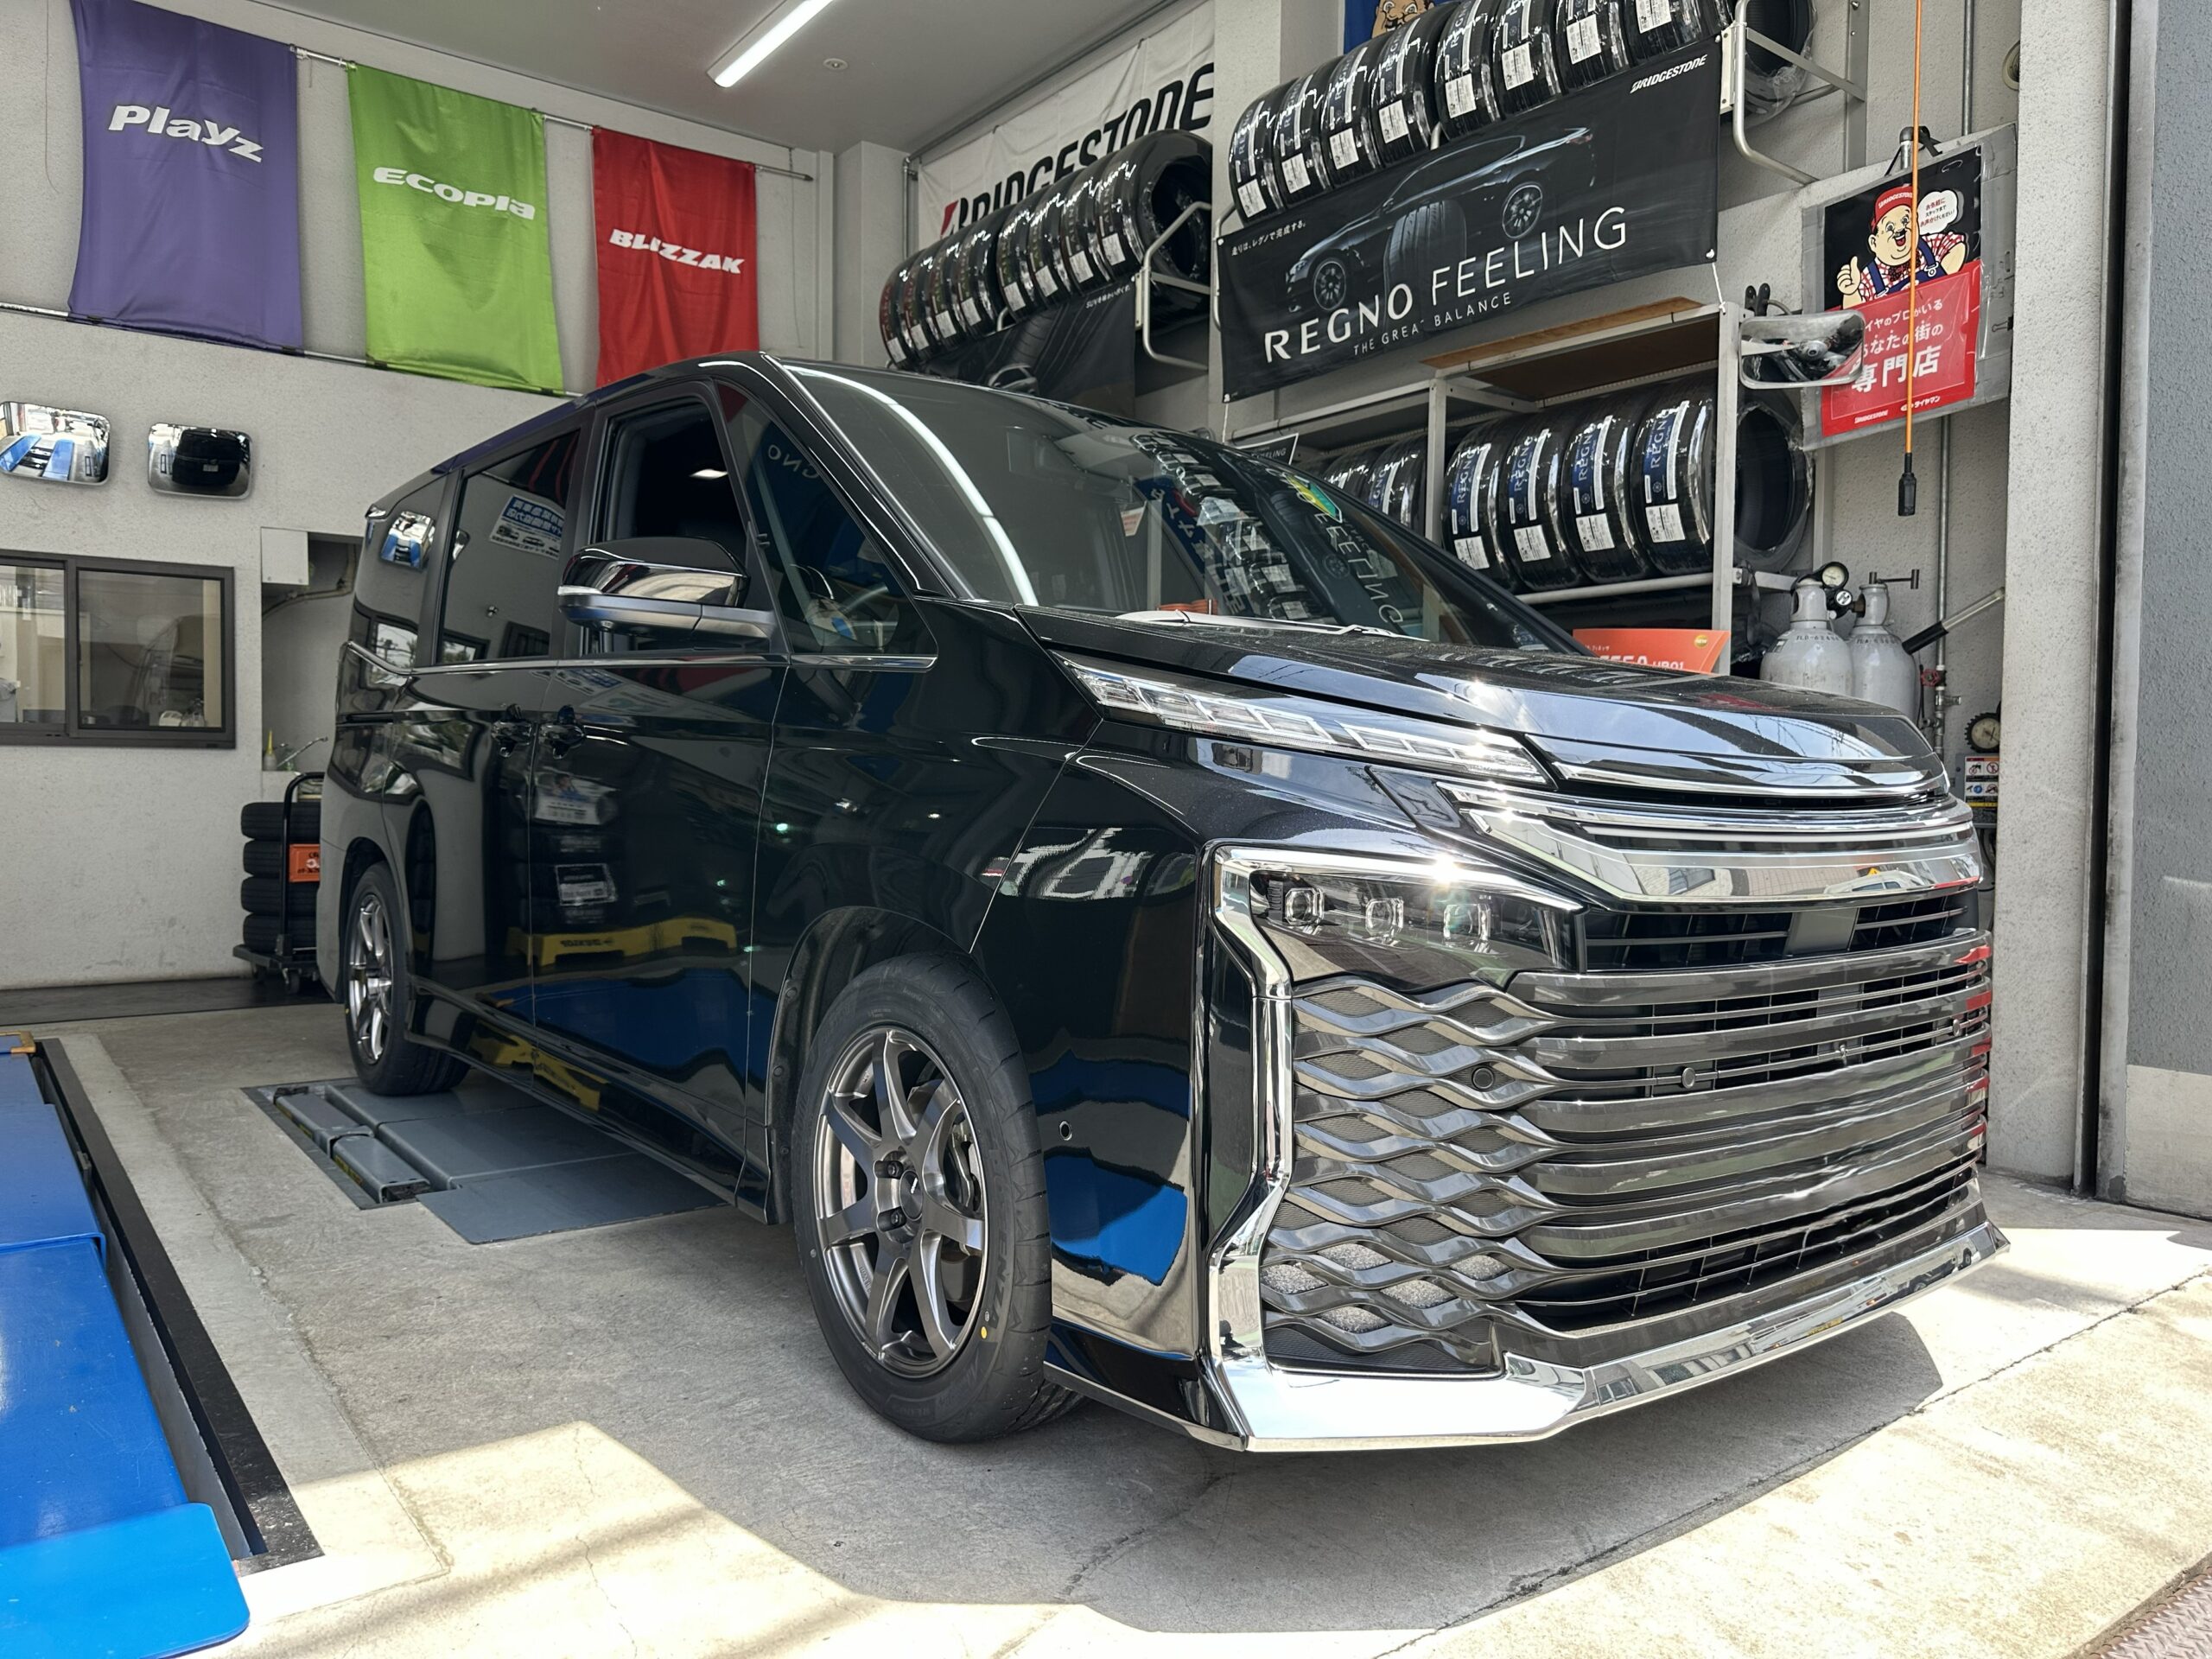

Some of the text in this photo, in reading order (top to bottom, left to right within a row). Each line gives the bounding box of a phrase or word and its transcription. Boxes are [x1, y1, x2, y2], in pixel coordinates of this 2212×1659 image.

[1630, 54, 1708, 94] BRIDGESTONE
[108, 105, 264, 163] Playz
[609, 229, 745, 275] BLIZZAK
[1265, 207, 1626, 364] REGNO FEELING
[1353, 337, 1376, 357] THE
[1434, 292, 1511, 327] BALANCE
[1865, 298, 1942, 333] イヤのプロがいる
[1852, 346, 1942, 393] 専門店
